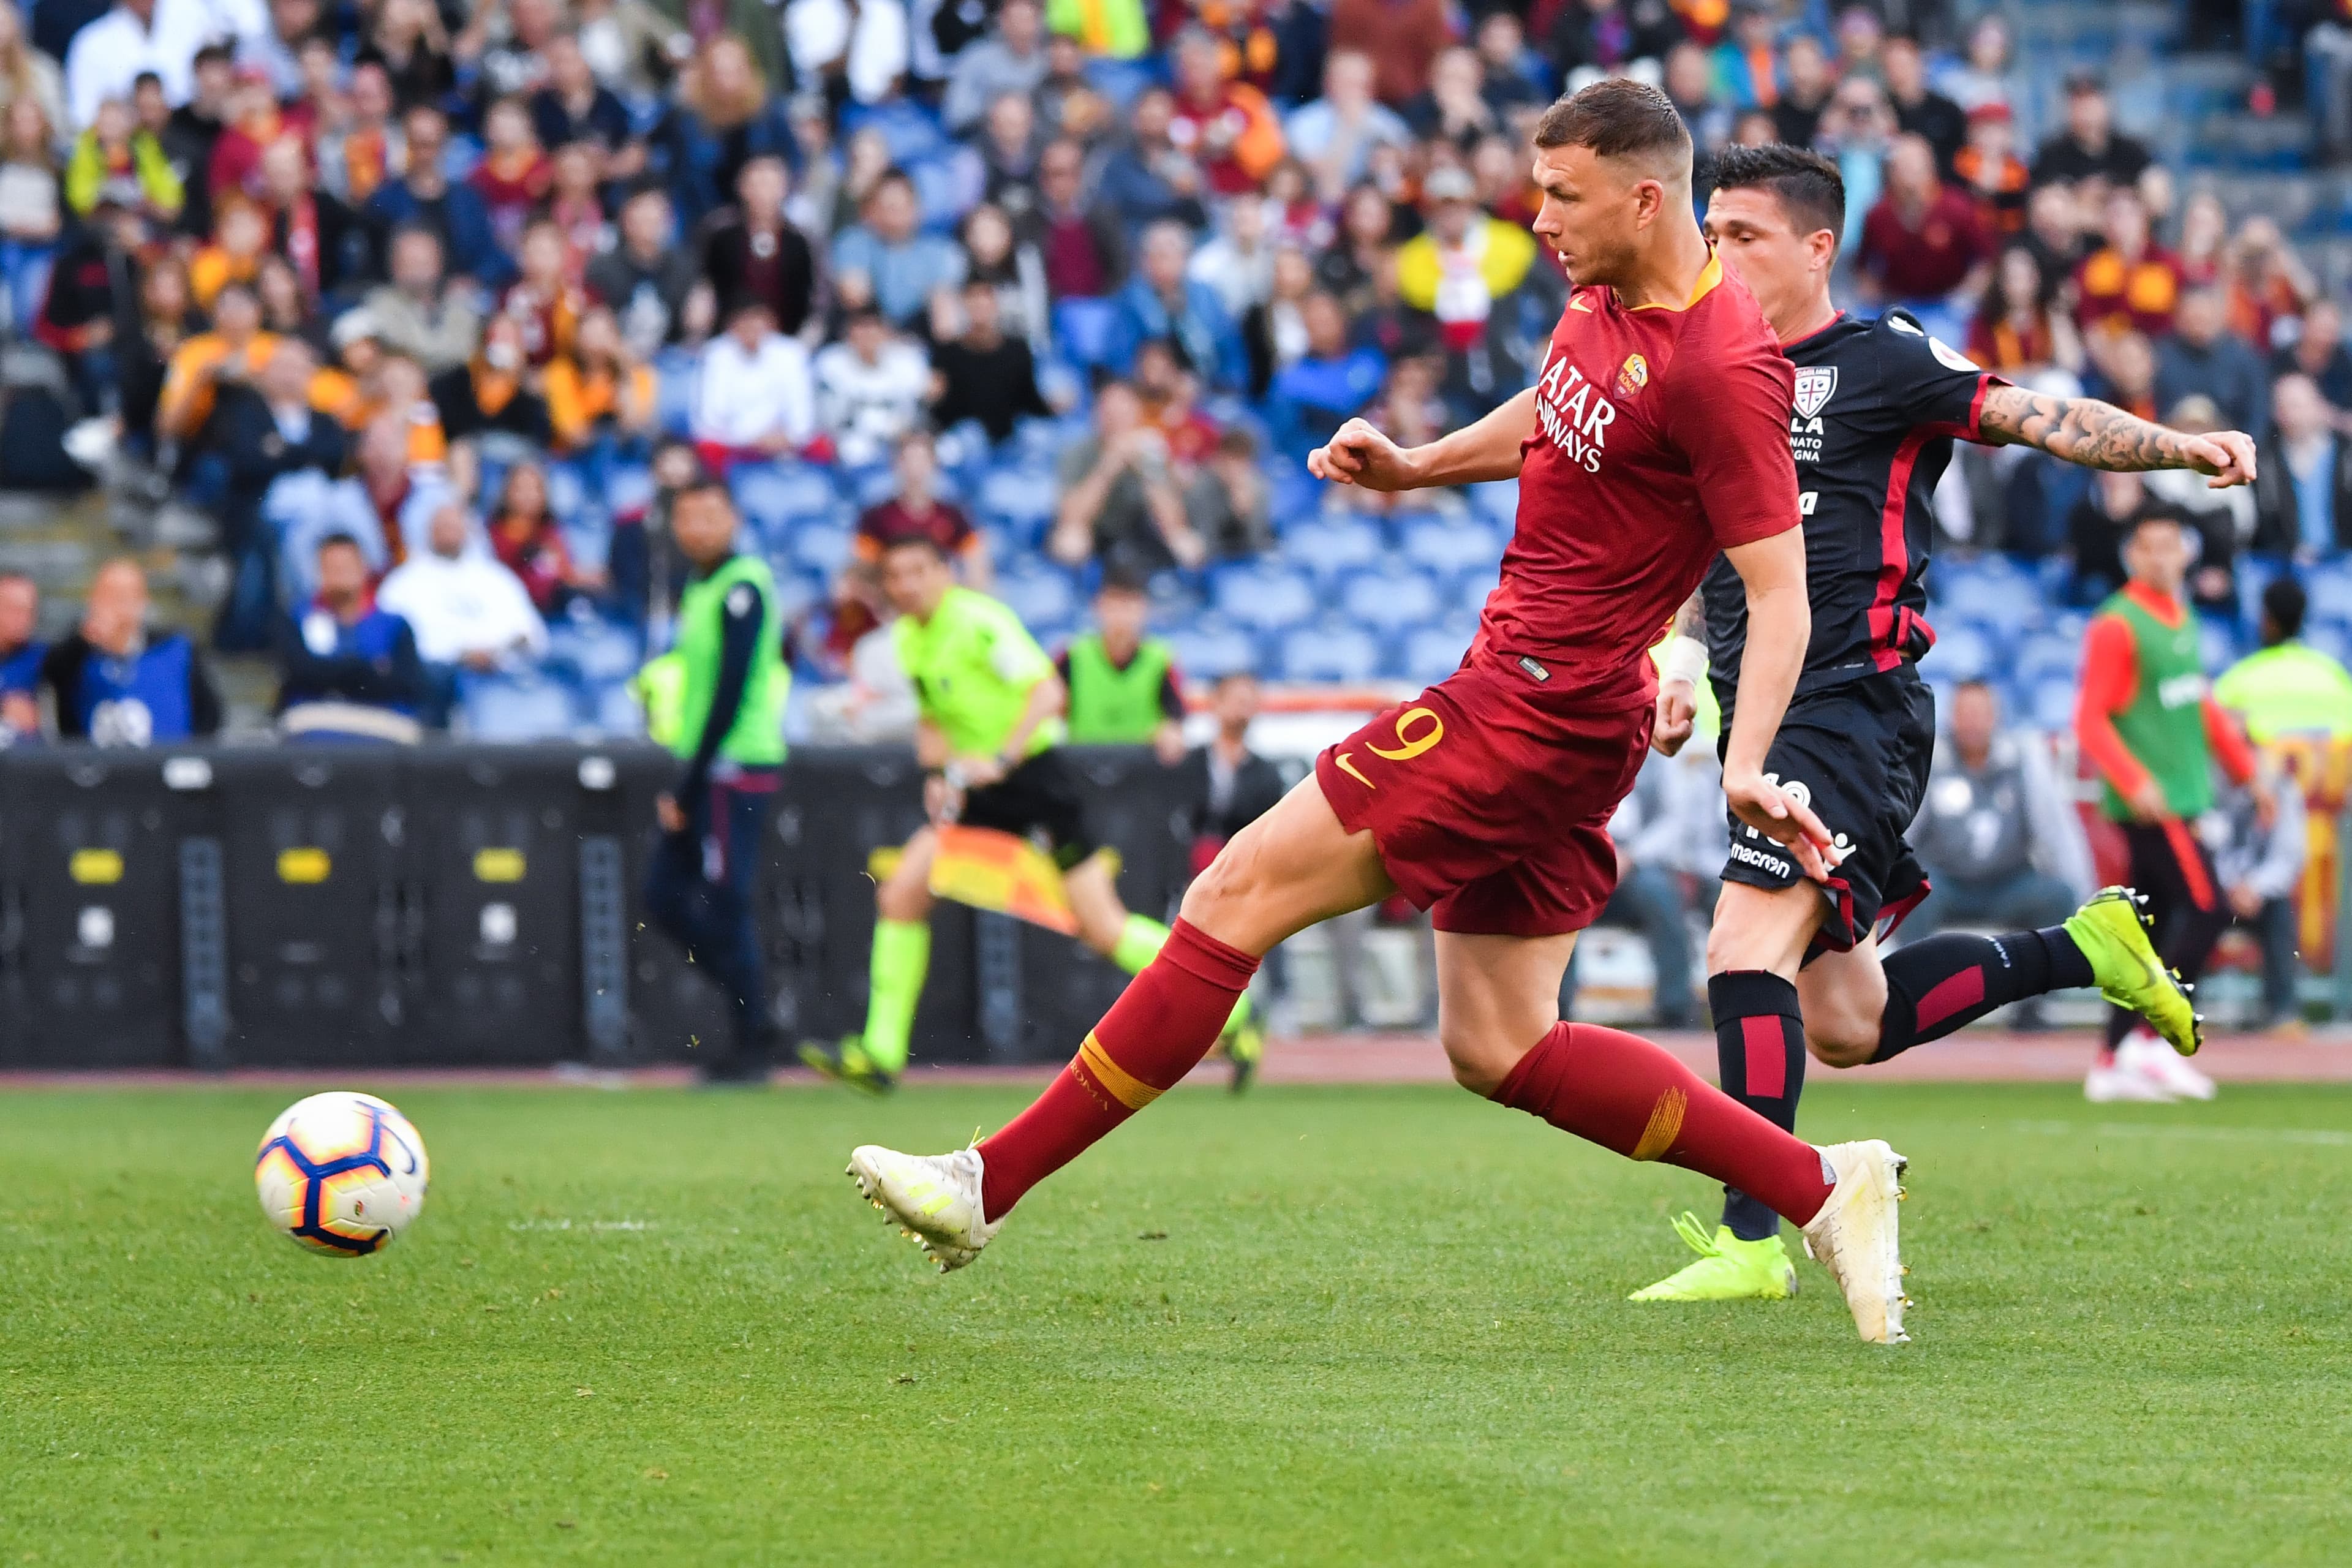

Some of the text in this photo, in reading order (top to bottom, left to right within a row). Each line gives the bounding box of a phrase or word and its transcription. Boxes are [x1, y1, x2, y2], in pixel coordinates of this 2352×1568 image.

[1540, 339, 1616, 448] ATAR
[1618, 372, 1636, 394] ROMA
[1789, 437, 1822, 449] NATO
[1792, 450, 1820, 462] GNA
[1365, 707, 1444, 760] 9
[1731, 843, 1790, 878] macron
